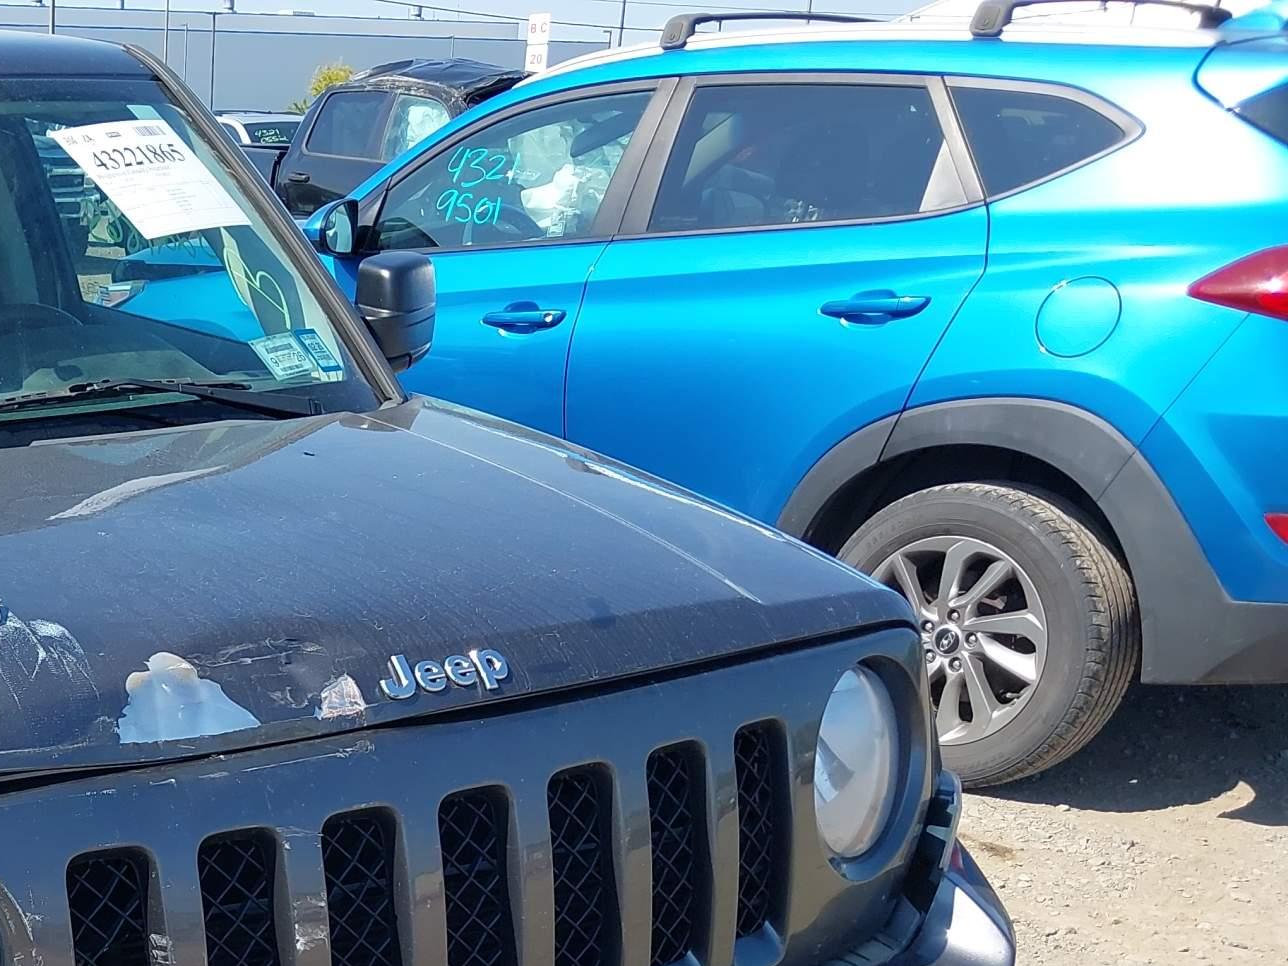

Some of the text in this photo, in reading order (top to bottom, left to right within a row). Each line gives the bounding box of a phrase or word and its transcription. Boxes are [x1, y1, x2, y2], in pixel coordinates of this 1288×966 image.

[92, 143, 185, 170] 43221865
[447, 147, 520, 188] 4321
[436, 189, 501, 225] 9501
[378, 648, 510, 700] Jeep
